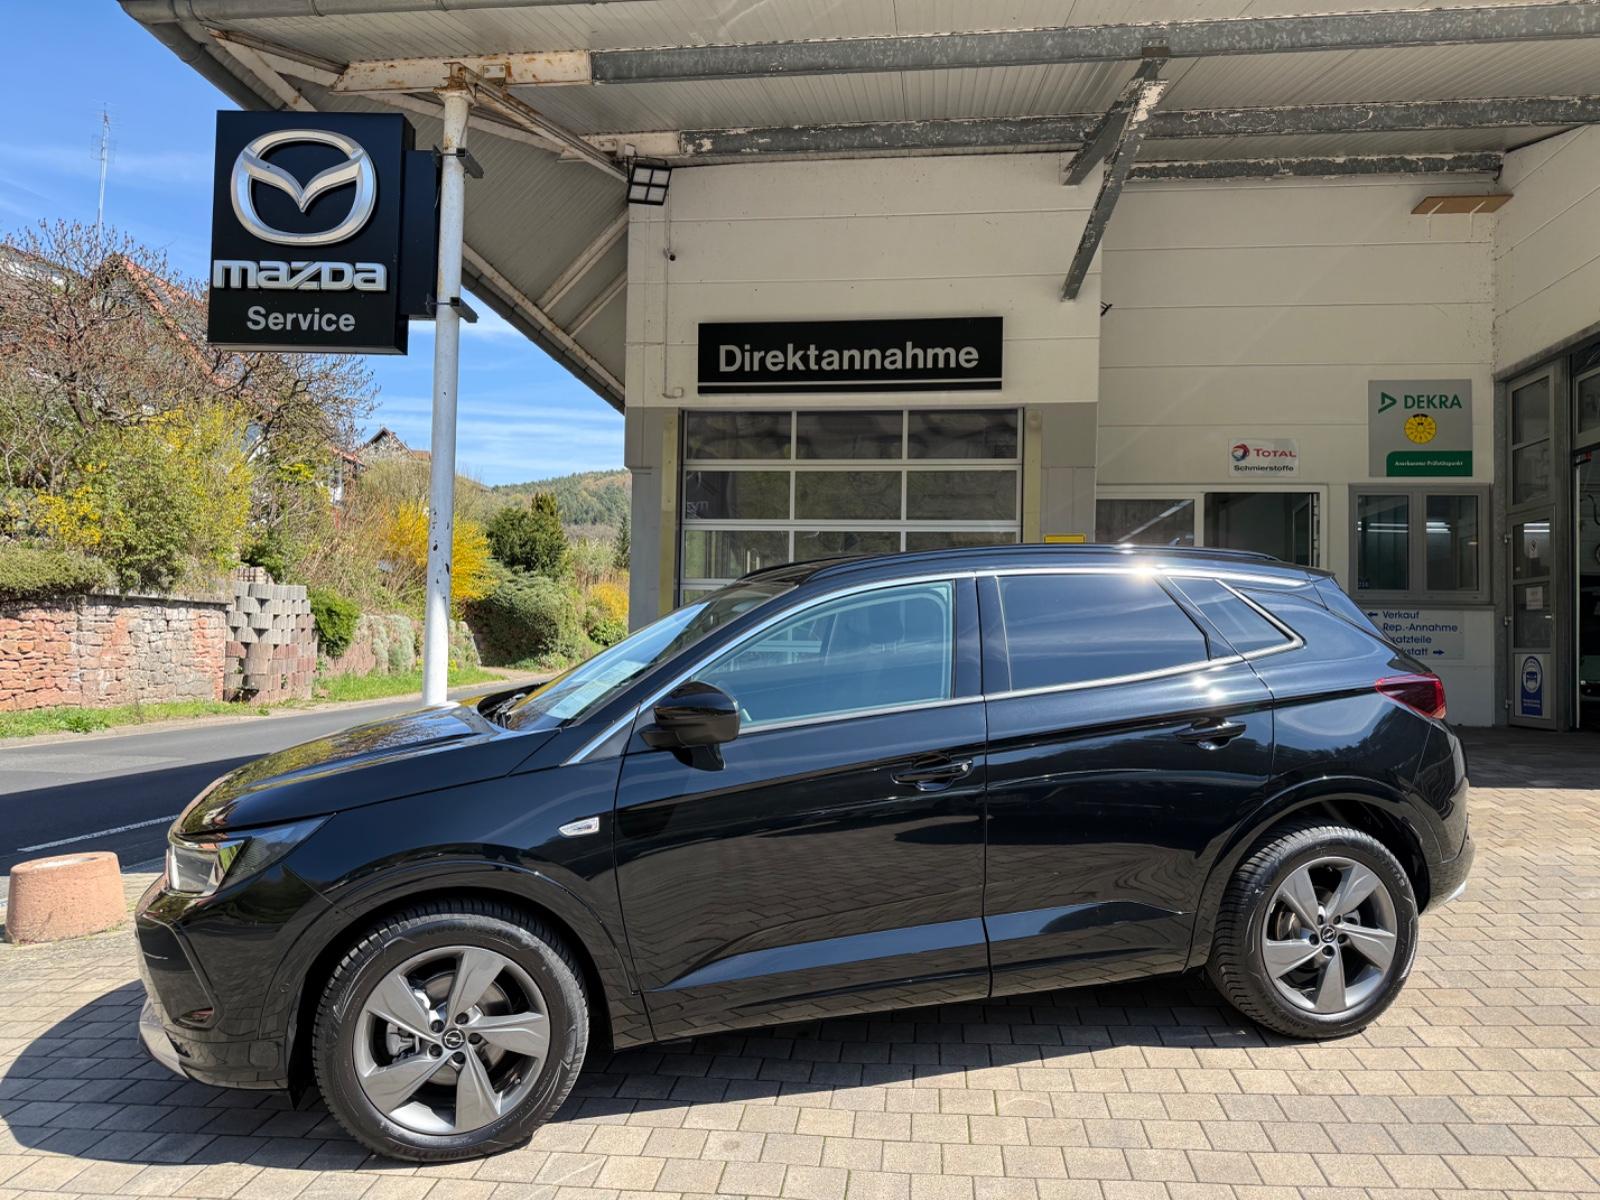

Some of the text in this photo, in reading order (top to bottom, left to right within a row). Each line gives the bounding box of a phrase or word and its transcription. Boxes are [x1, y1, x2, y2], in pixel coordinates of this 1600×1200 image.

[246, 306, 356, 331] Service
[718, 341, 979, 372] Direktannahme
[1403, 393, 1463, 409] DEKRA
[1253, 448, 1297, 458] TOTAL
[1233, 464, 1295, 472] Schmierstoffe
[1382, 610, 1420, 619] Verkauf
[1383, 623, 1458, 632] Rep.-Annahme
